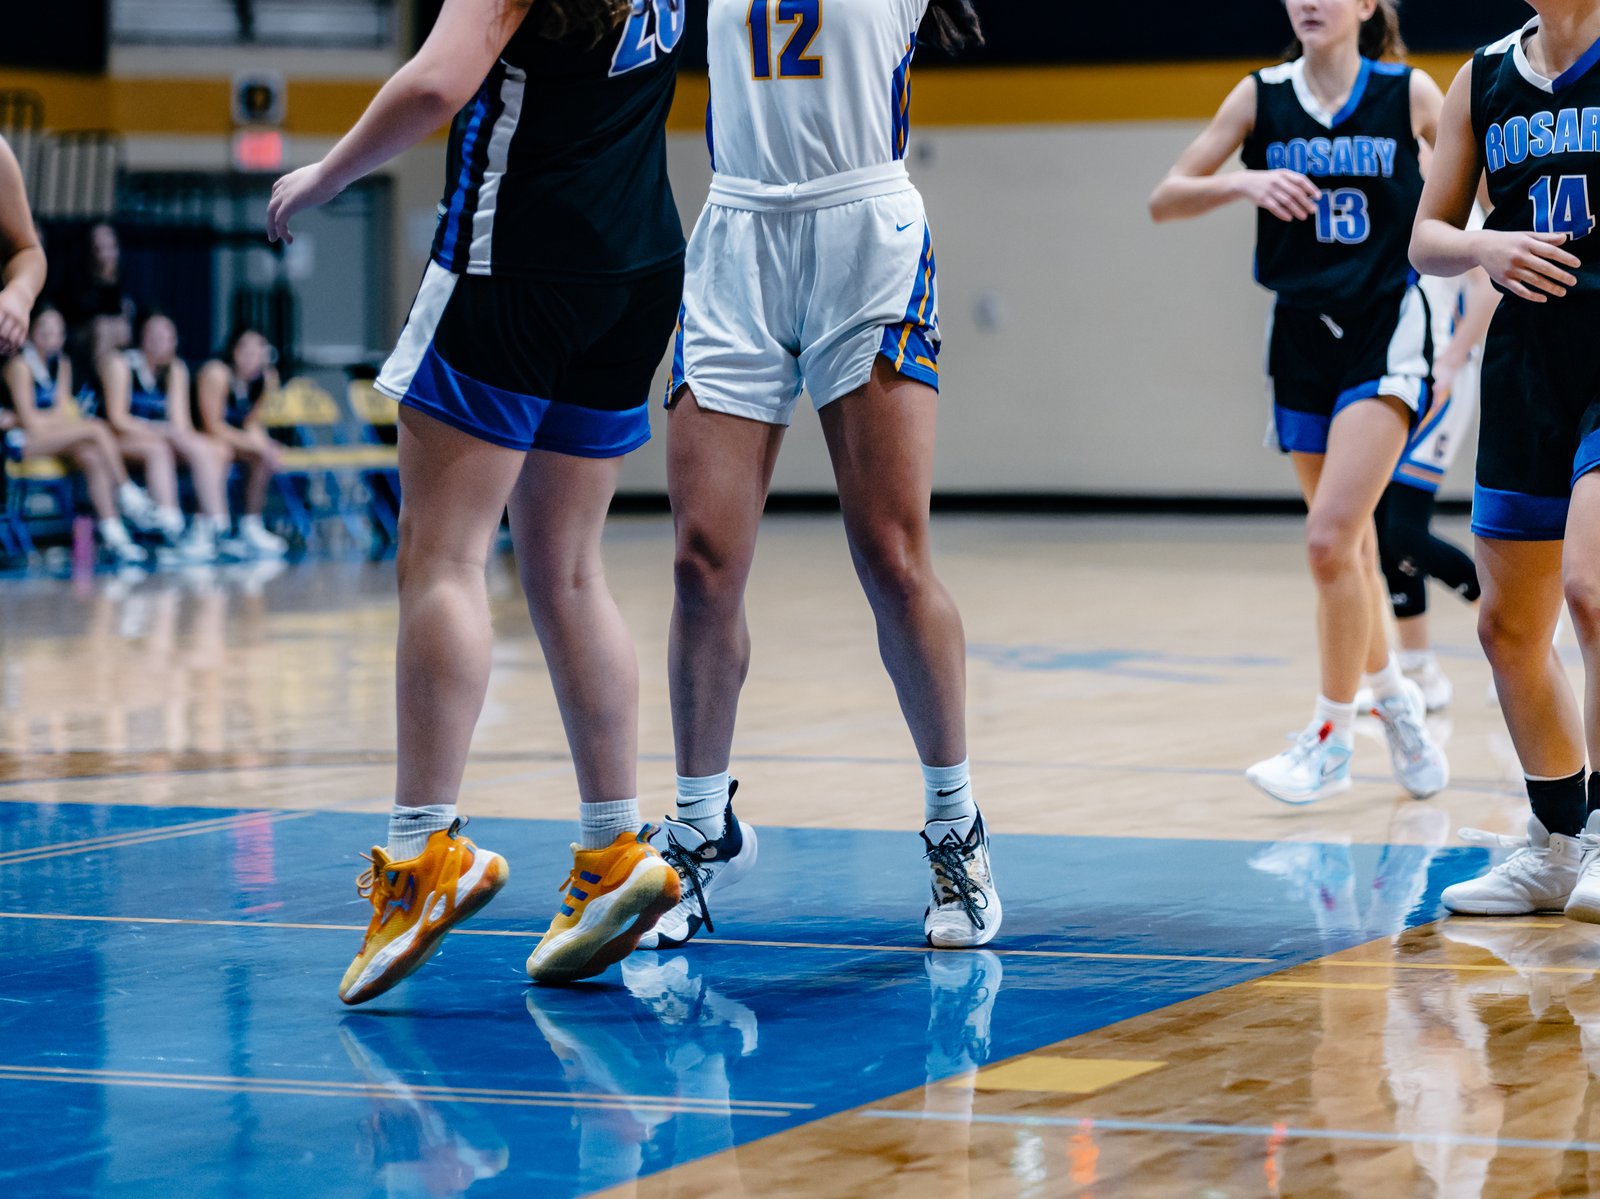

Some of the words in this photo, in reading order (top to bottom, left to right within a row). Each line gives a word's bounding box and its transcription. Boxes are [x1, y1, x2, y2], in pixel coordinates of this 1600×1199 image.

[1266, 135, 1397, 178] ROSARY
[1315, 188, 1371, 245] 13
[1528, 174, 1595, 240] 14
